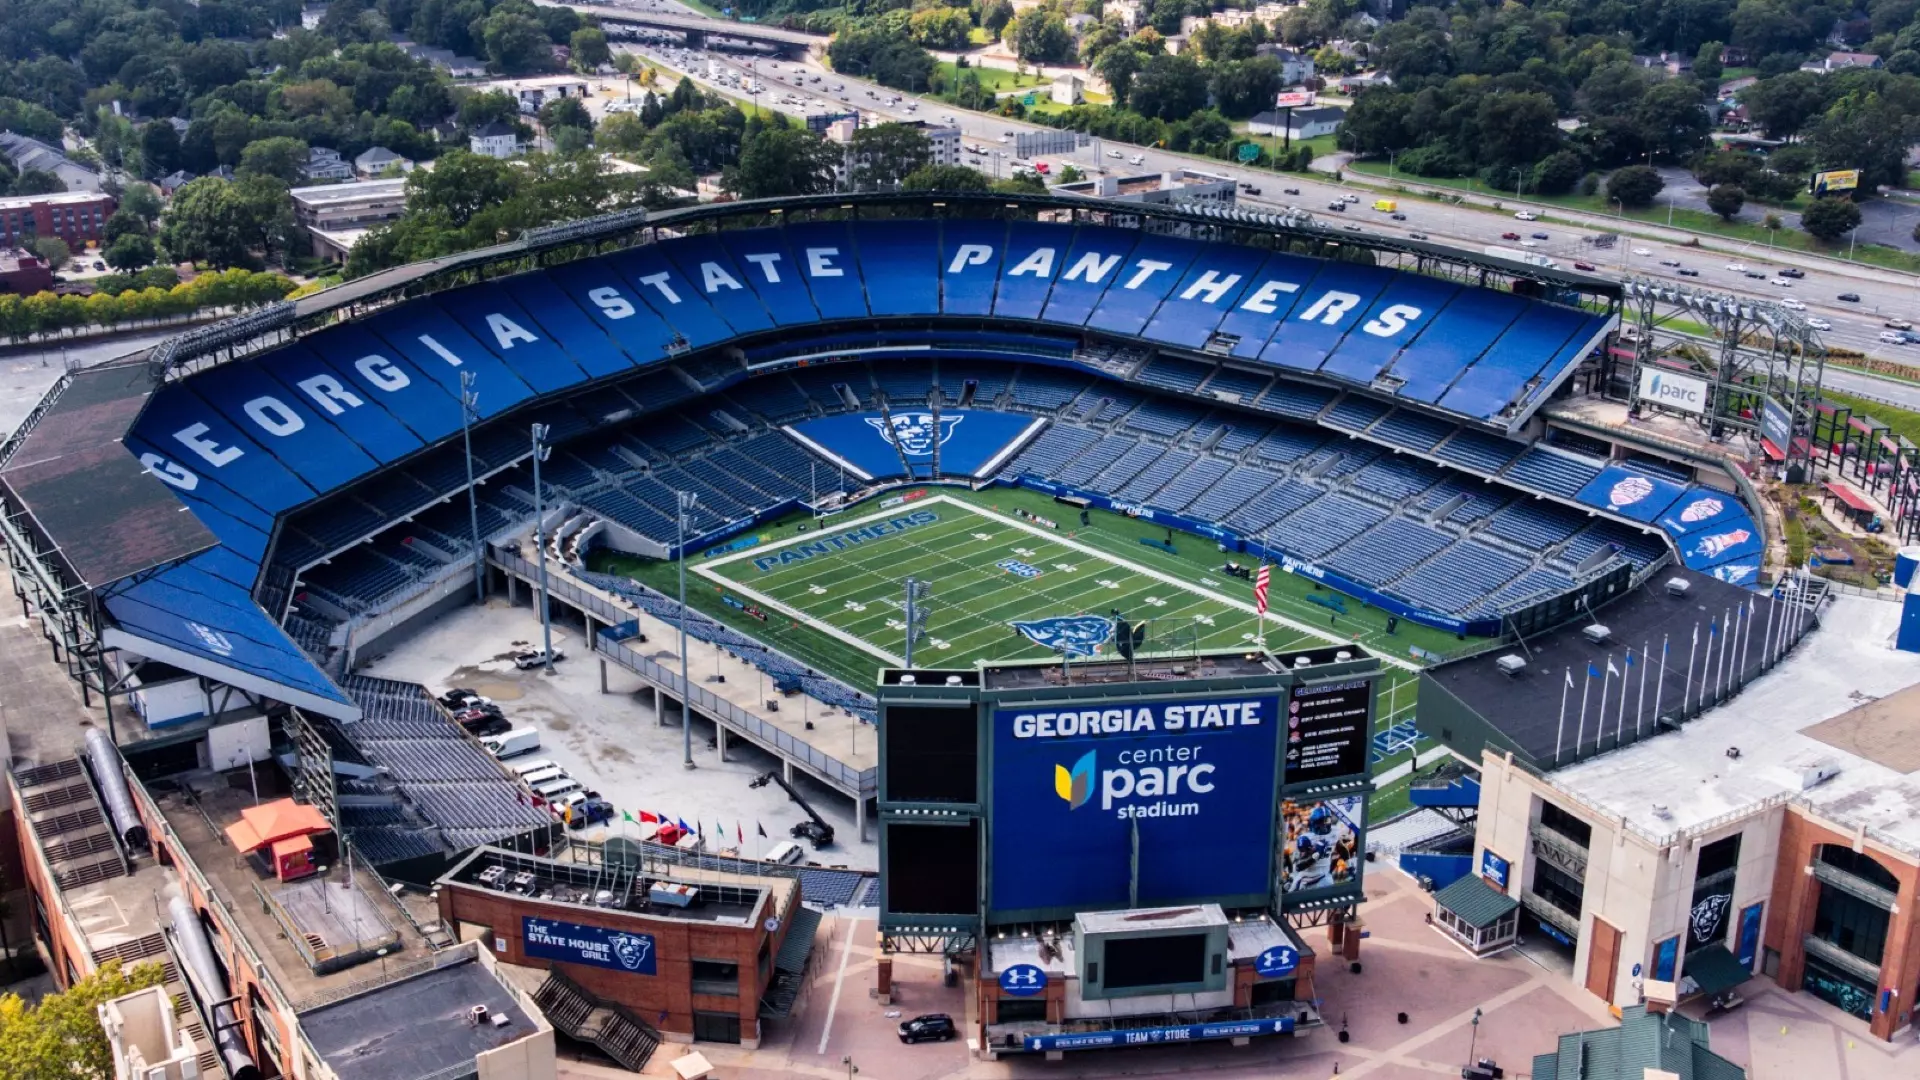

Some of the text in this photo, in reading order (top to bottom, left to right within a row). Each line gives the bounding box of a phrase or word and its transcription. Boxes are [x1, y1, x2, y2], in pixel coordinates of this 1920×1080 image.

[140, 243, 1422, 491] GEORGIA STATE PANTHERS
[1660, 383, 1697, 402] parc
[753, 510, 939, 572] PANTHERS
[1013, 702, 1261, 738] GEORGIA STATE
[1118, 744, 1202, 764] center
[1102, 763, 1216, 810] parc
[1117, 800, 1199, 819] stadium
[528, 924, 548, 934] THE
[528, 933, 610, 953] STATE HOUSE
[581, 950, 611, 961] GRILL
[1125, 1029, 1190, 1043] TEAM STORE
